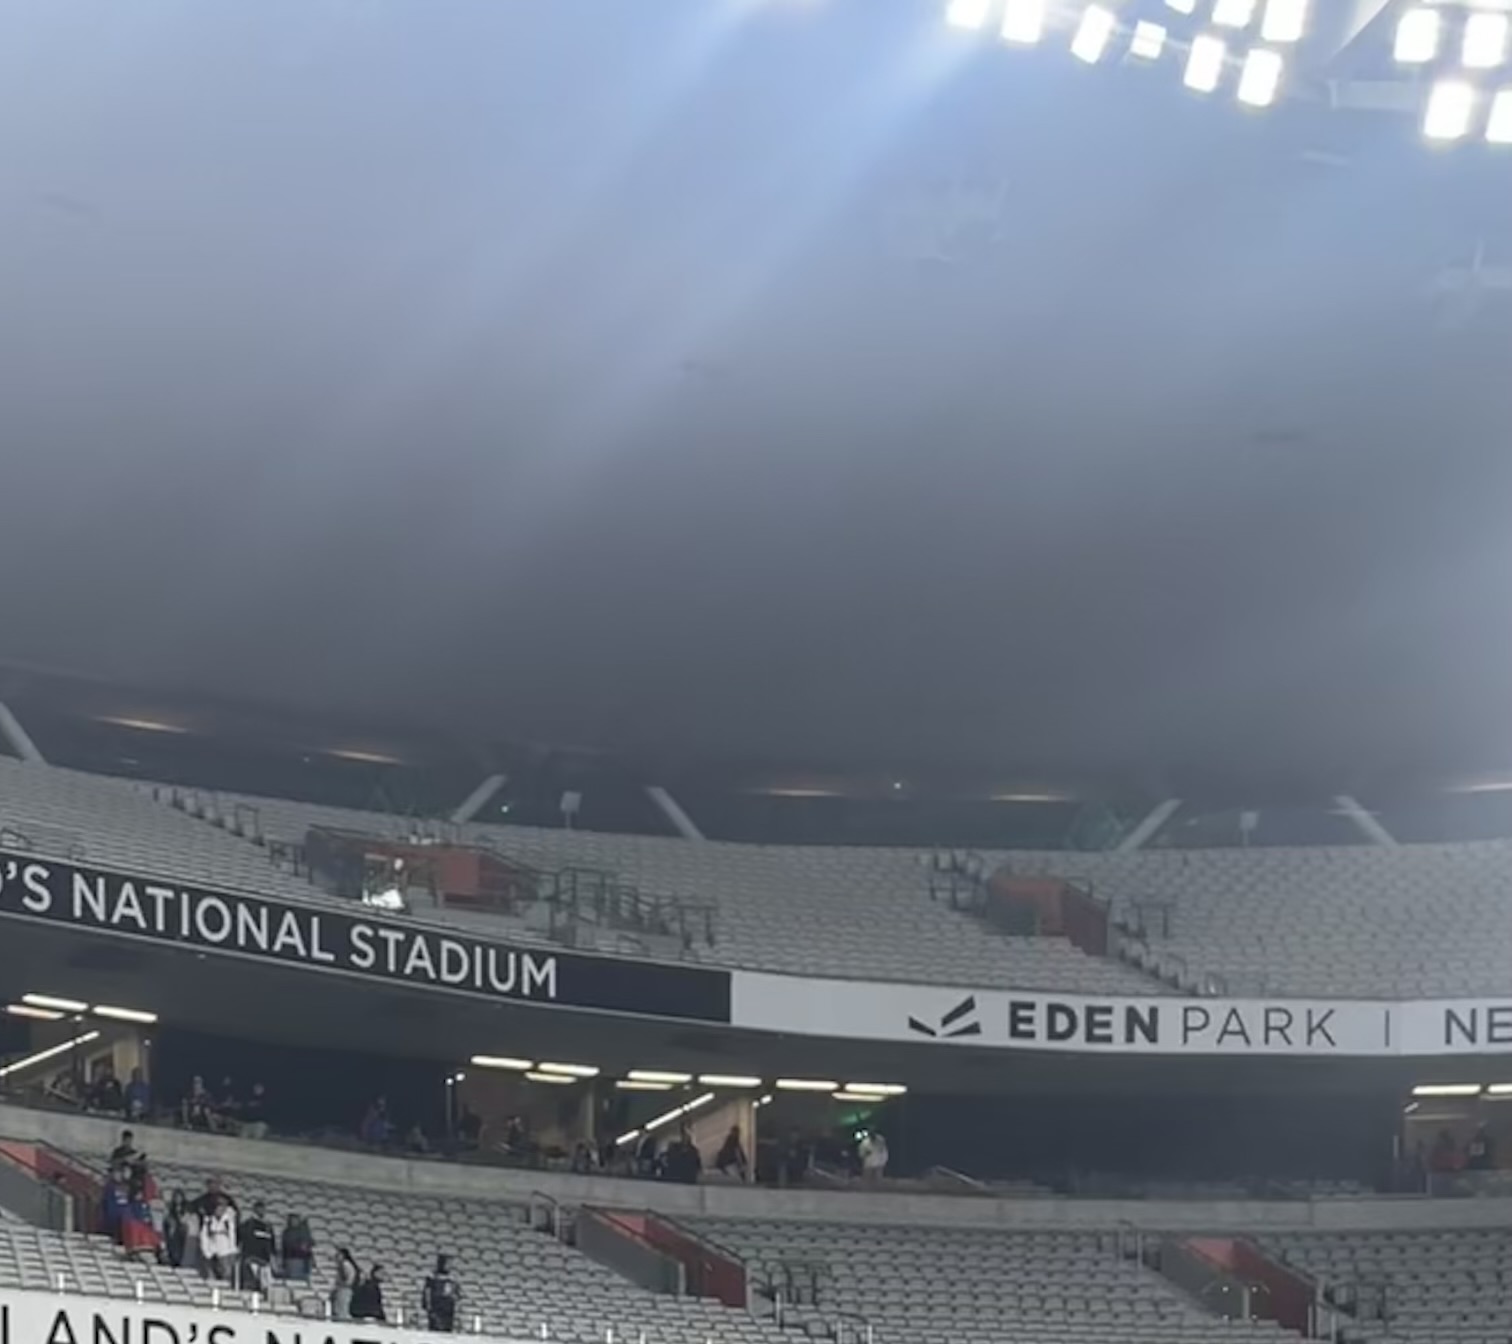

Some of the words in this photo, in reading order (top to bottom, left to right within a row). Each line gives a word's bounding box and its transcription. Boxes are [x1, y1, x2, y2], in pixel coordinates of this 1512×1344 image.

[73, 875, 335, 963] NATIONAL
[350, 924, 557, 997] STADIUM
[1009, 1001, 1159, 1044] EDEN
[1182, 1006, 1336, 1046] PARK
